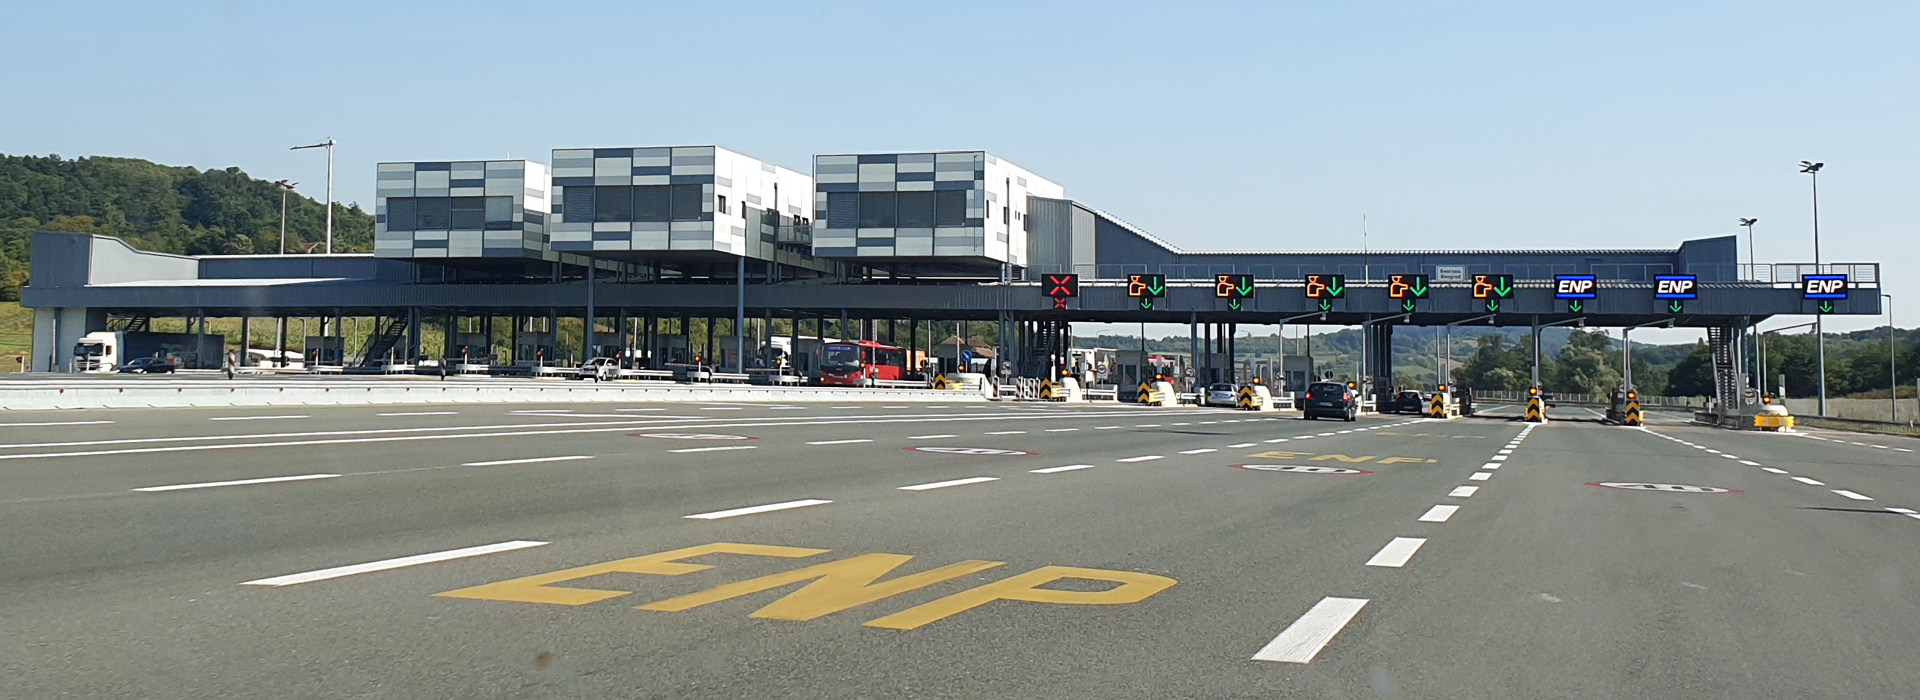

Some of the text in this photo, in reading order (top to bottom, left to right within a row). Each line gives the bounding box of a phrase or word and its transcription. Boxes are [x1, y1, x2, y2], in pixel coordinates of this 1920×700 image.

[1558, 280, 1593, 293] ENP
[1657, 280, 1693, 293] ENP
[1806, 280, 1844, 293] ENP
[432, 542, 1177, 630] ENP
